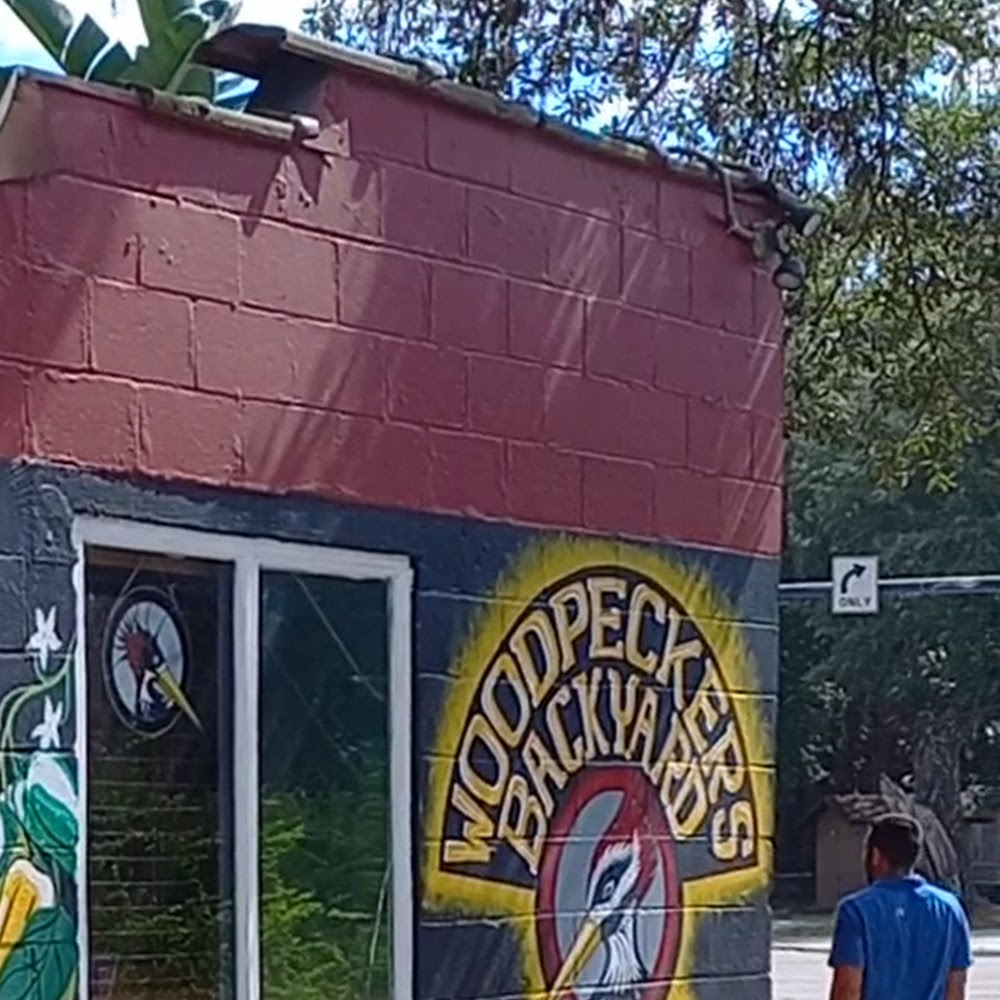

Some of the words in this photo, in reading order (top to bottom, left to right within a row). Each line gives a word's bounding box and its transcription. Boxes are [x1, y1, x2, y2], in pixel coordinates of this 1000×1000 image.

[838, 597, 872, 608] ONLY
[443, 576, 753, 863] WOODPECKERS
[497, 667, 708, 875] BACKYARD
